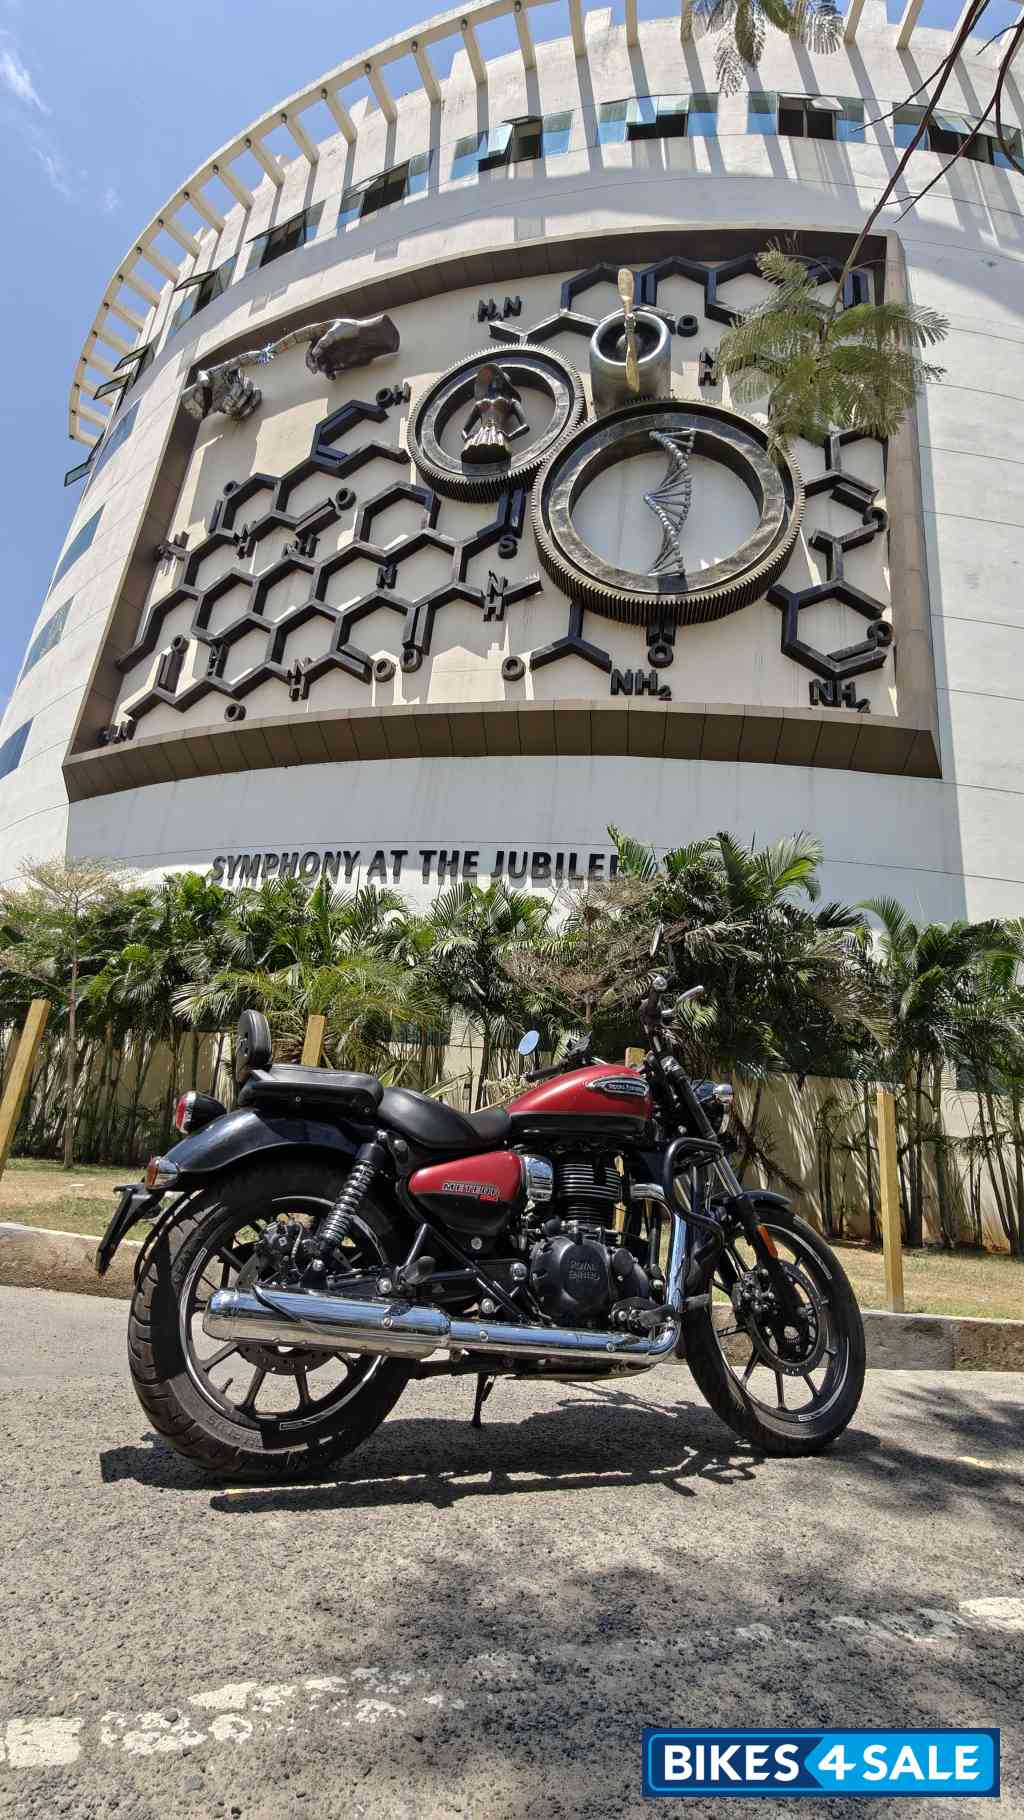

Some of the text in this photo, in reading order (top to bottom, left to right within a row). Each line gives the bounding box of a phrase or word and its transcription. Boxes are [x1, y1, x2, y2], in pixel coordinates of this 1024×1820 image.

[212, 850, 360, 882] SYMPHONY
[367, 850, 408, 877] AT
[419, 850, 479, 878] THE
